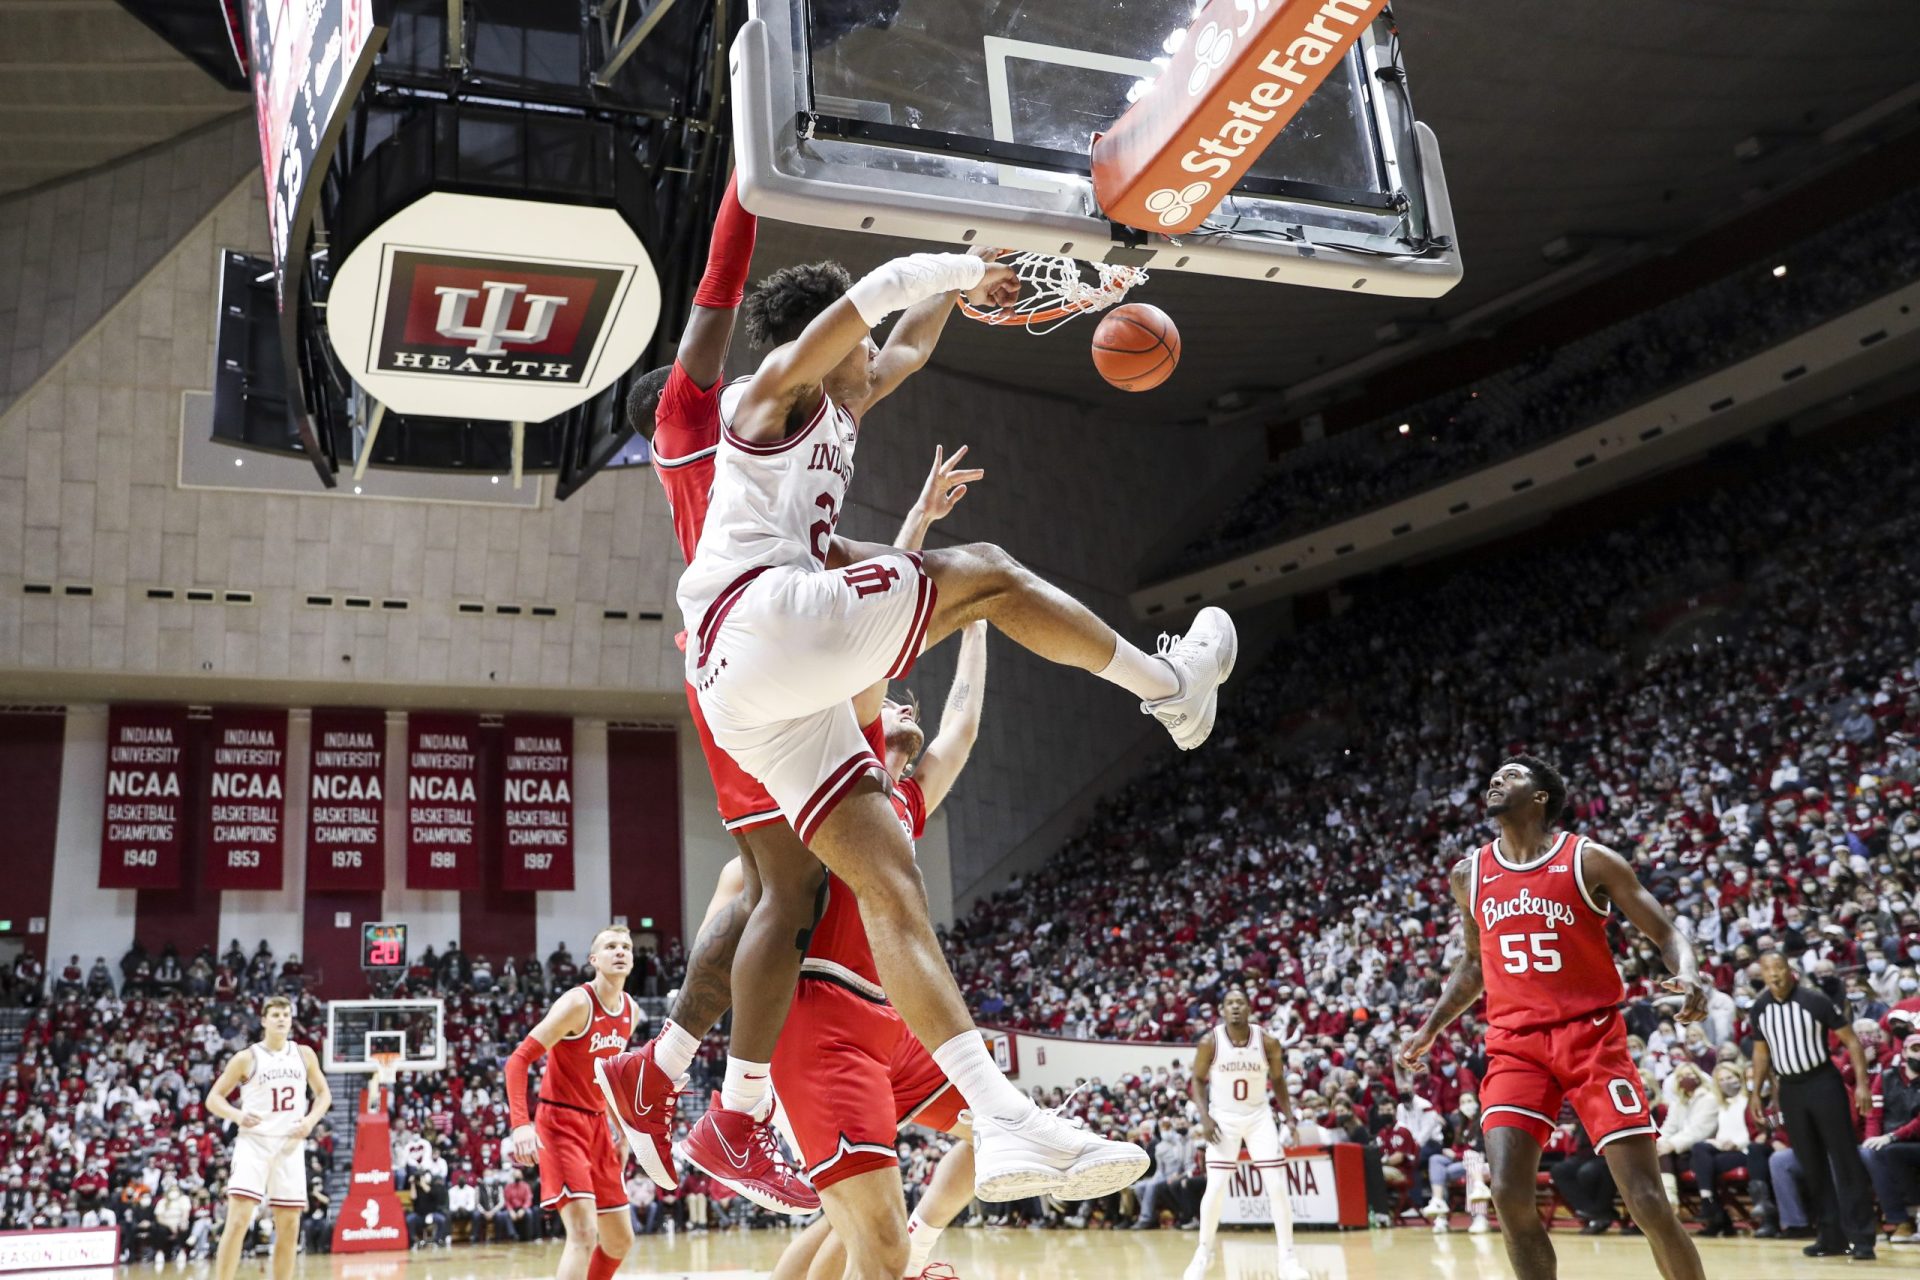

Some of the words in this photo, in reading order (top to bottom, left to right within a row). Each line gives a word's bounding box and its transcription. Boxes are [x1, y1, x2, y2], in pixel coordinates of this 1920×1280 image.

[393, 351, 573, 379] HEALTH
[120, 727, 173, 744] INDIANA
[224, 729, 275, 746] INDIANA
[324, 732, 374, 748] INDIANA
[419, 734, 469, 751] INDIANA
[514, 737, 562, 753] INDIANA
[111, 746, 181, 764] UNIVERSITY
[215, 748, 282, 766] UNIVERSITY
[315, 751, 381, 768] UNIVERSITY
[411, 752, 475, 770] UNIVERSITY
[507, 755, 569, 772] UNIVERSITY
[107, 770, 181, 797] NCAA
[211, 772, 283, 800] NCAA
[312, 774, 382, 801] NCAA
[409, 775, 477, 802] NCAA
[504, 778, 571, 803] NCAA
[107, 803, 177, 822] BASKETBALL
[211, 805, 279, 824] BASKETBALL
[312, 806, 379, 825] BASKETBALL
[410, 807, 474, 825] BASKETBALL
[506, 809, 569, 827] BASKETBALL
[108, 824, 173, 842] CHAMPIONS
[213, 825, 277, 843] CHAMPIONS
[315, 826, 377, 844] CHAMPIONS
[412, 826, 472, 844] CHAMPIONS
[509, 829, 568, 846] CHAMPIONS
[123, 849, 158, 867] 1940
[227, 849, 260, 868] 1953
[332, 850, 362, 868] 1976
[430, 851, 456, 869] 1981
[524, 852, 553, 870] 1987
[1481, 887, 1575, 931] Buckeyes
[370, 940, 400, 965] 20
[1499, 932, 1562, 974] 55
[1218, 1060, 1263, 1073] INDIANA
[258, 1067, 302, 1086] INDIANA
[1233, 1078, 1248, 1101] 0
[271, 1086, 296, 1113] 12
[1228, 1159, 1320, 1197] INDNA
